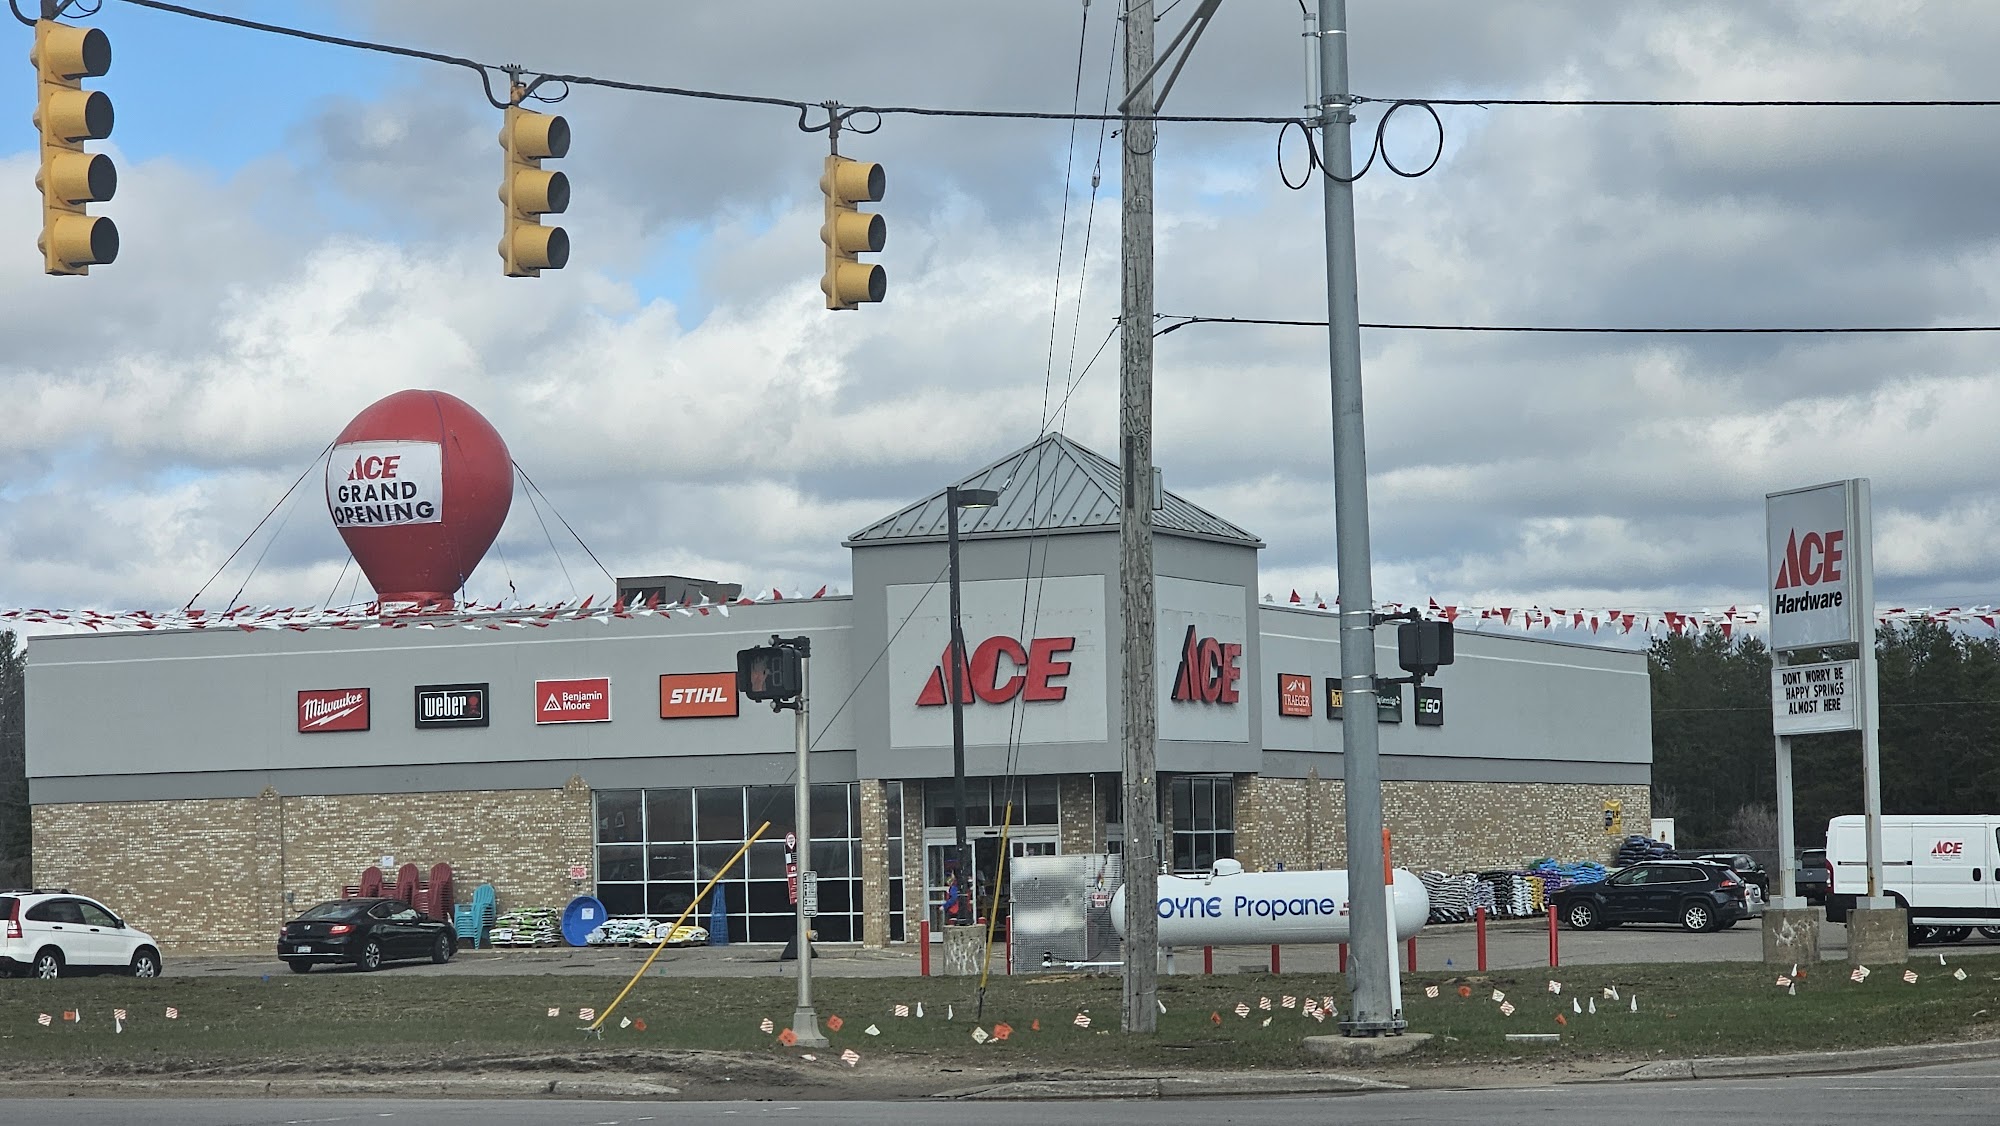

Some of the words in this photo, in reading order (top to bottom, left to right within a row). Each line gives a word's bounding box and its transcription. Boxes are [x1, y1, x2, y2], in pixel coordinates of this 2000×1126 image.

[348, 454, 400, 480] ACE
[338, 481, 417, 503] GRAND
[334, 501, 434, 524] OPENING
[1774, 528, 1844, 589] ACE
[1775, 591, 1842, 615] Hardware
[915, 625, 1076, 706] ACE
[1171, 624, 1242, 704] ACE
[1782, 671, 1801, 685] DONT
[1805, 668, 1830, 683] WORRY
[1834, 667, 1844, 680] BE
[562, 691, 602, 702] Benjamin
[669, 687, 728, 704] STIHL
[1284, 693, 1310, 707] TRAEGER
[1786, 685, 1809, 700] HAPPY
[1814, 682, 1844, 698] SPRINGS
[301, 692, 363, 720] Milwaukee
[424, 691, 467, 717] weber
[562, 701, 591, 710] Moore
[1419, 699, 1441, 713] EGO
[1789, 700, 1817, 715] ALMOST
[1824, 698, 1841, 711] HERE
[1931, 840, 1963, 854] ACE
[1157, 896, 1222, 919] OYNE
[1234, 896, 1335, 921] Propane
